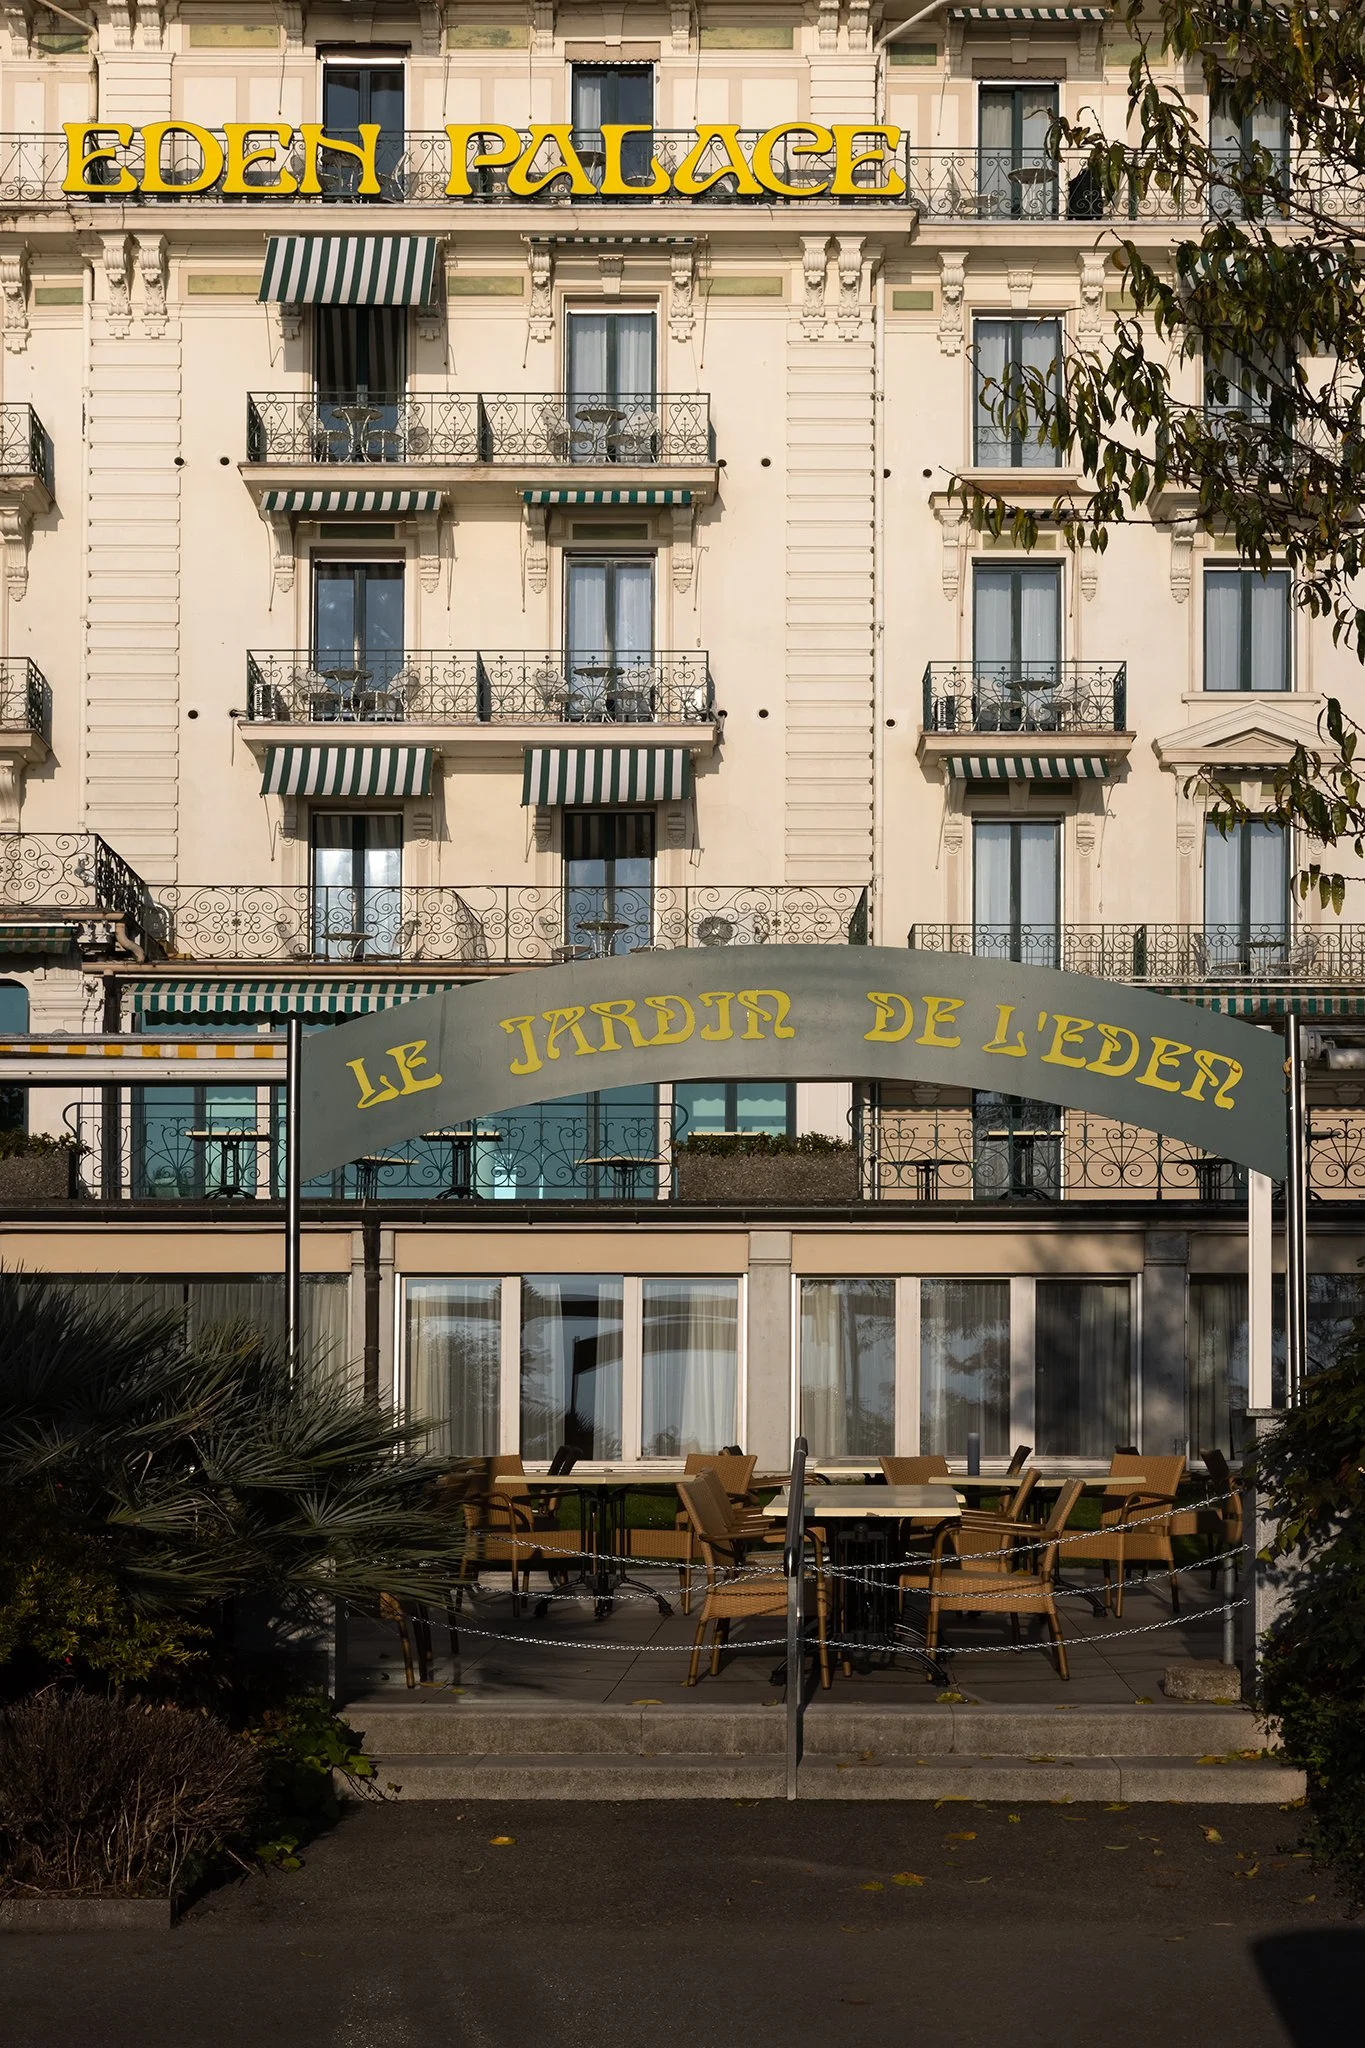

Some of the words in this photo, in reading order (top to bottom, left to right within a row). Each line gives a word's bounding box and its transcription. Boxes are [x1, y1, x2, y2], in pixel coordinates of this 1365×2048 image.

[61, 120, 381, 196] EDEN
[445, 121, 908, 198] PALACE
[345, 1038, 443, 1110] LE
[499, 988, 796, 1077] JARDIN
[863, 990, 966, 1049] DE
[981, 1003, 1244, 1111] L'EDEN
